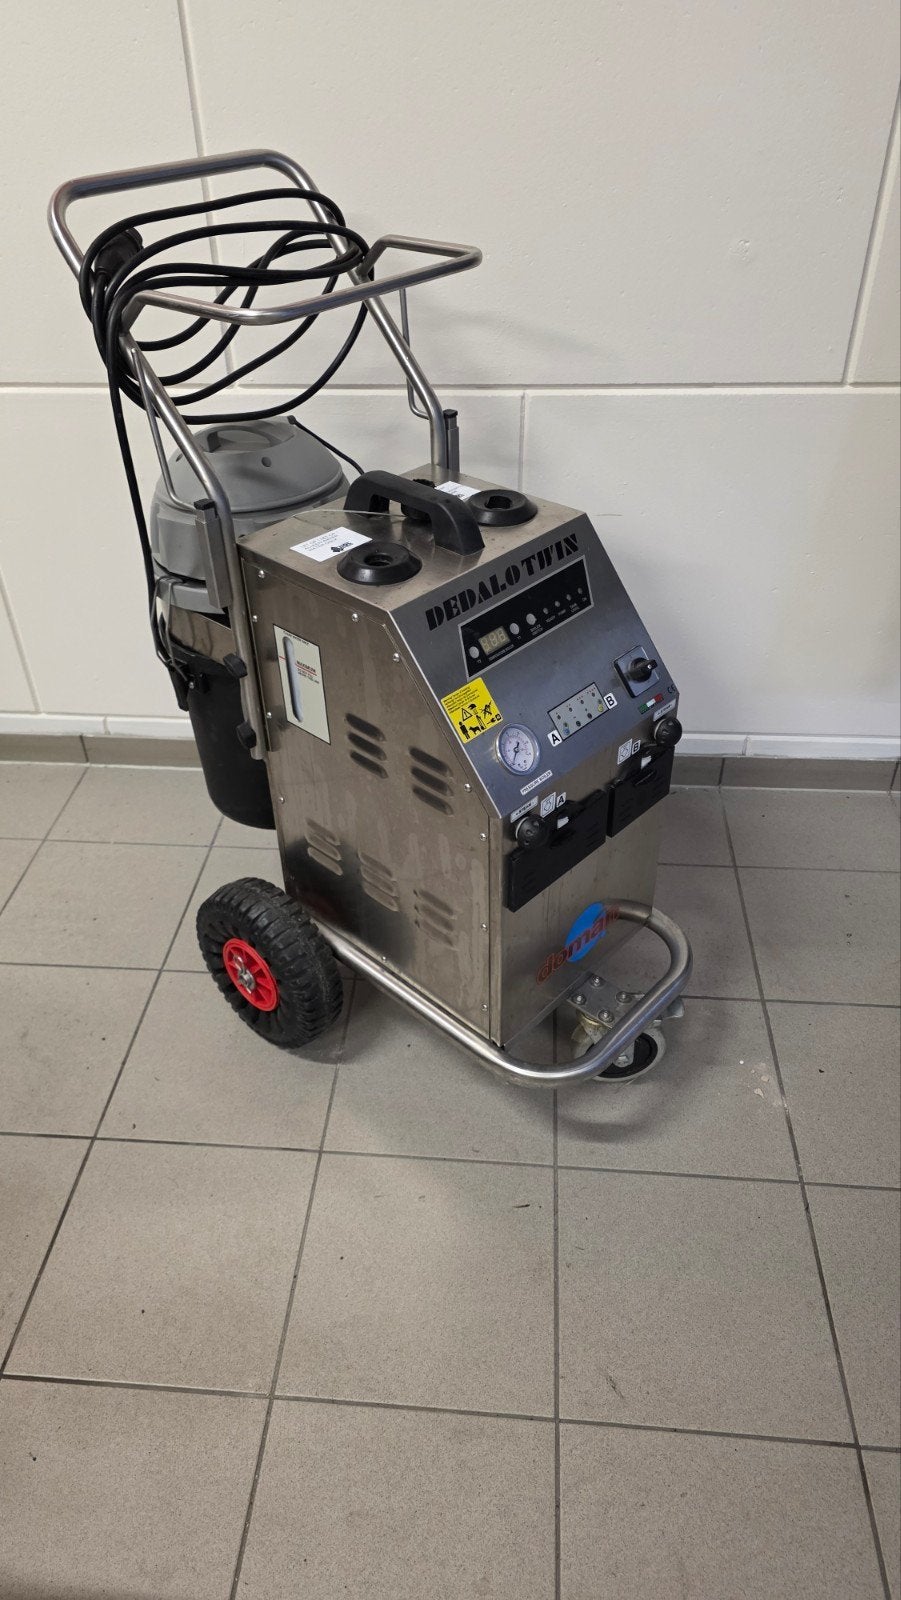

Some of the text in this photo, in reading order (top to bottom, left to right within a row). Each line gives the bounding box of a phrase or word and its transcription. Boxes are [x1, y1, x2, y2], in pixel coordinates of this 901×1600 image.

[425, 533, 579, 631] DEDALO TWIN
[605, 695, 615, 707] B
[551, 733, 561, 745] A
